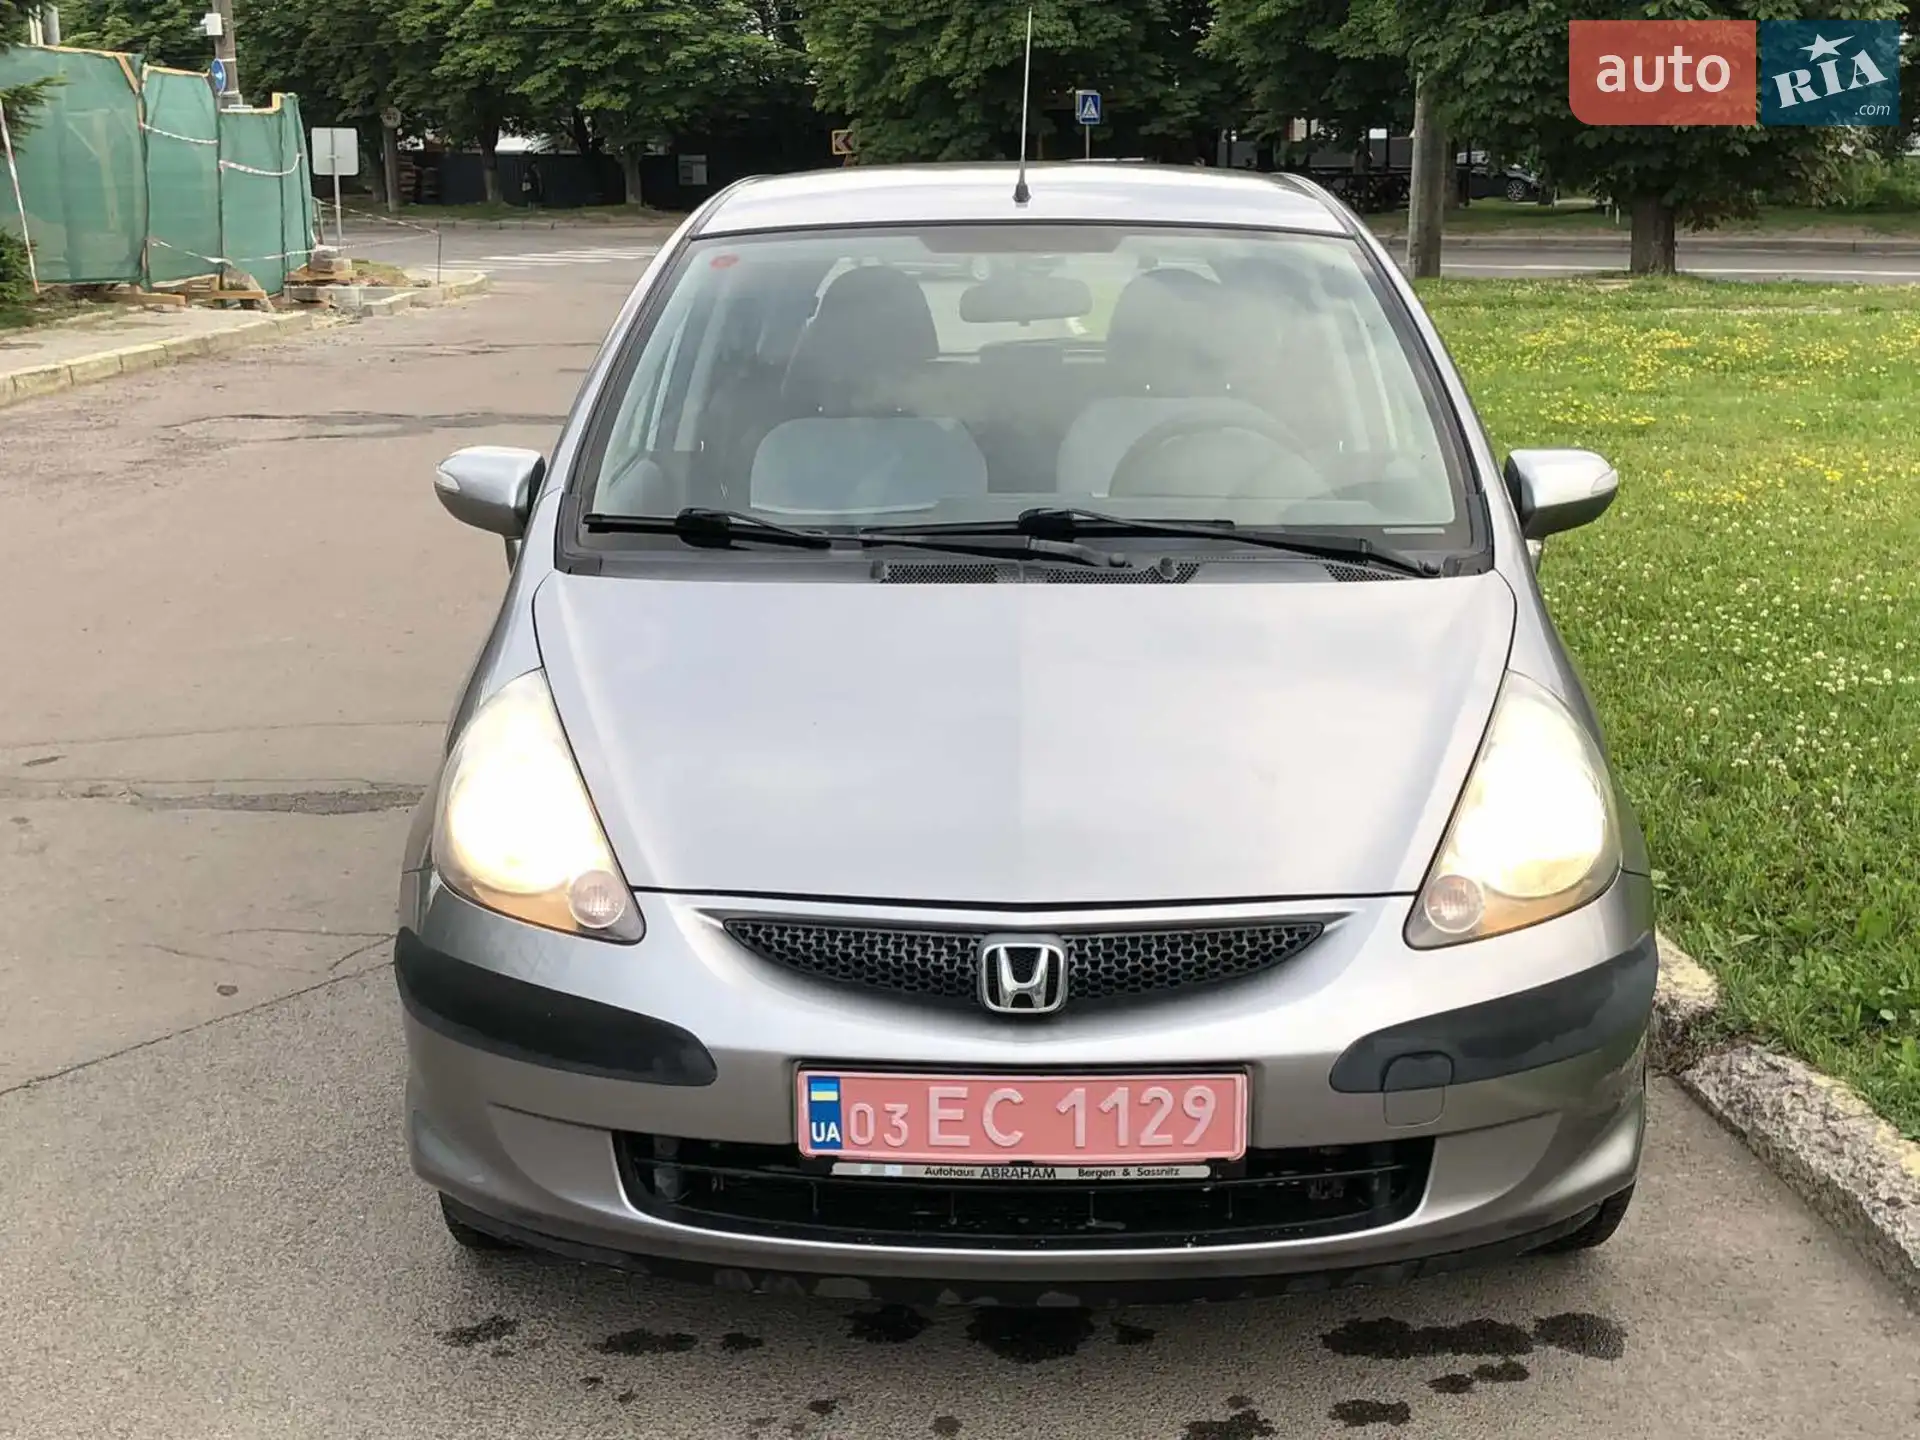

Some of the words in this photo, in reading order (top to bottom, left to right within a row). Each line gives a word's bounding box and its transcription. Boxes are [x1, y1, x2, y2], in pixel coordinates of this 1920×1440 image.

[848, 1103, 909, 1147] 03
[928, 1086, 1024, 1148] EC
[1055, 1086, 1217, 1148] 1129
[812, 1121, 841, 1142] UA
[924, 1167, 975, 1178] Autohaus
[980, 1167, 1056, 1180] ABRAHAM
[1078, 1168, 1116, 1179] Bergen
[1122, 1168, 1131, 1178] &
[1137, 1166, 1180, 1178] Sassnitz
